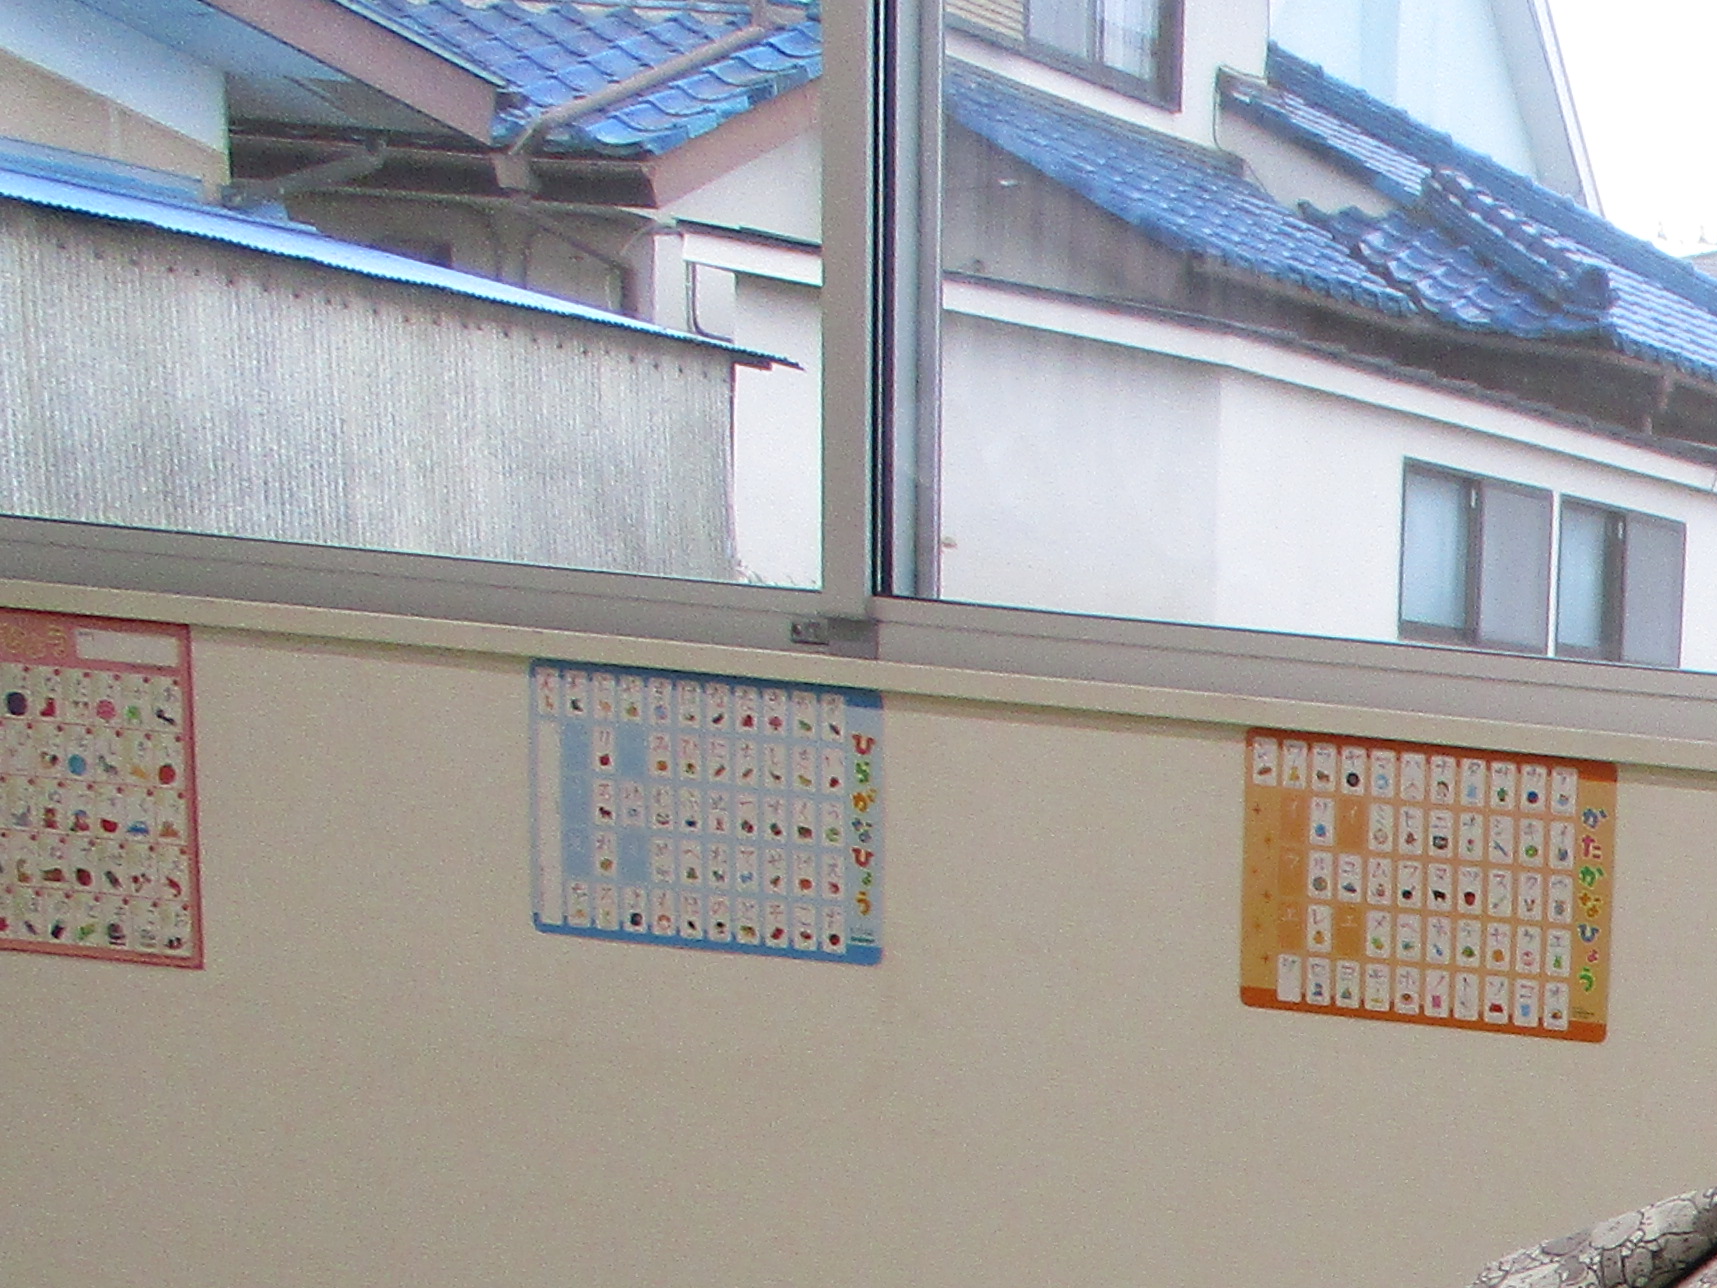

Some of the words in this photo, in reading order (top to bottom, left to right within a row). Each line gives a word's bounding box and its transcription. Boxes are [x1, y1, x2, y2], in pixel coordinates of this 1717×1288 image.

[851, 733, 878, 916] ひらがなひょう
[1578, 806, 1608, 993] かたかなひょう
